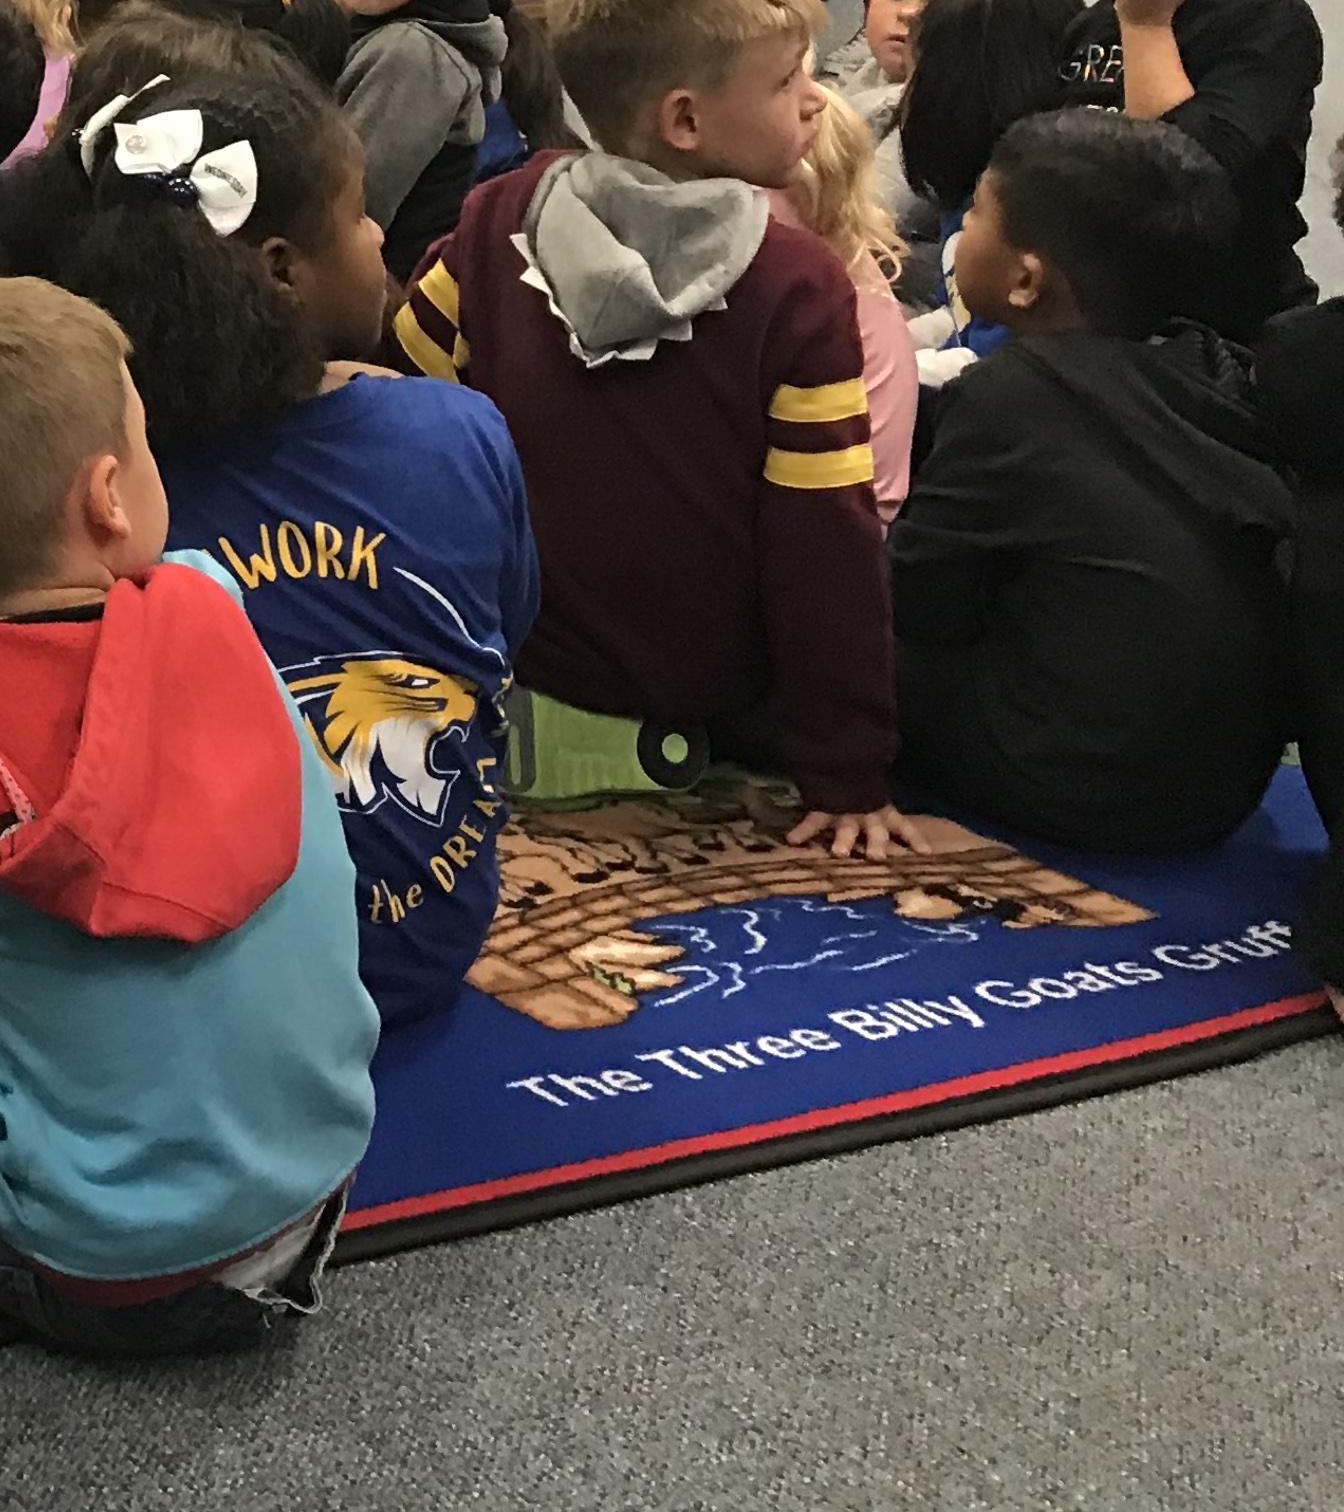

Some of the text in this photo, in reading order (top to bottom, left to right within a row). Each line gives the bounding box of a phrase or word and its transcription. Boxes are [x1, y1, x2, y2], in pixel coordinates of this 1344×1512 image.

[1058, 44, 1124, 83] GRE
[216, 519, 387, 590] WORK
[368, 878, 424, 924] the
[505, 920, 1292, 1107] The Three Billy Goats Gruff
